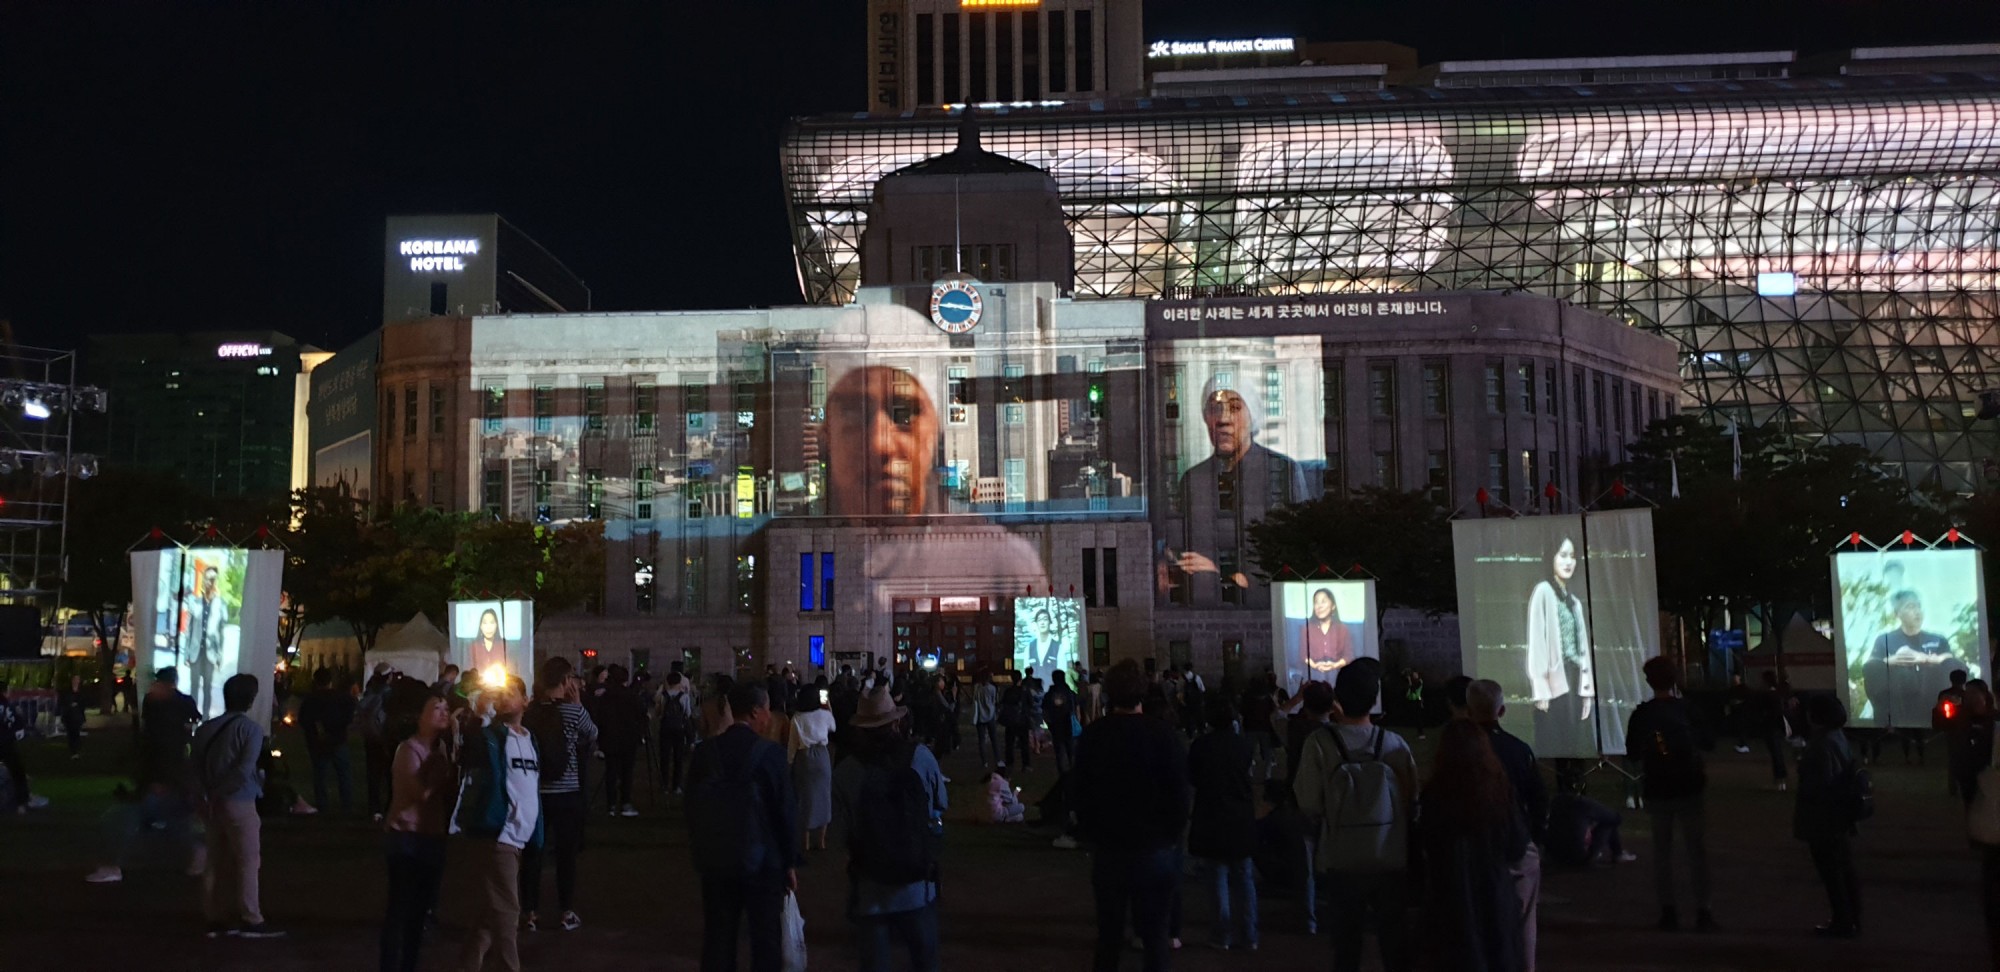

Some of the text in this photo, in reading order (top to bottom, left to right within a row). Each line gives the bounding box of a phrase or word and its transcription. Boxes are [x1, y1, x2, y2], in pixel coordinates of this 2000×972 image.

[400, 239, 478, 255] KOREANA
[410, 256, 464, 271] HOTEL
[1163, 300, 1447, 321] 이러한 사례는 세계 곳곳에서 여전히 존재합니다.
